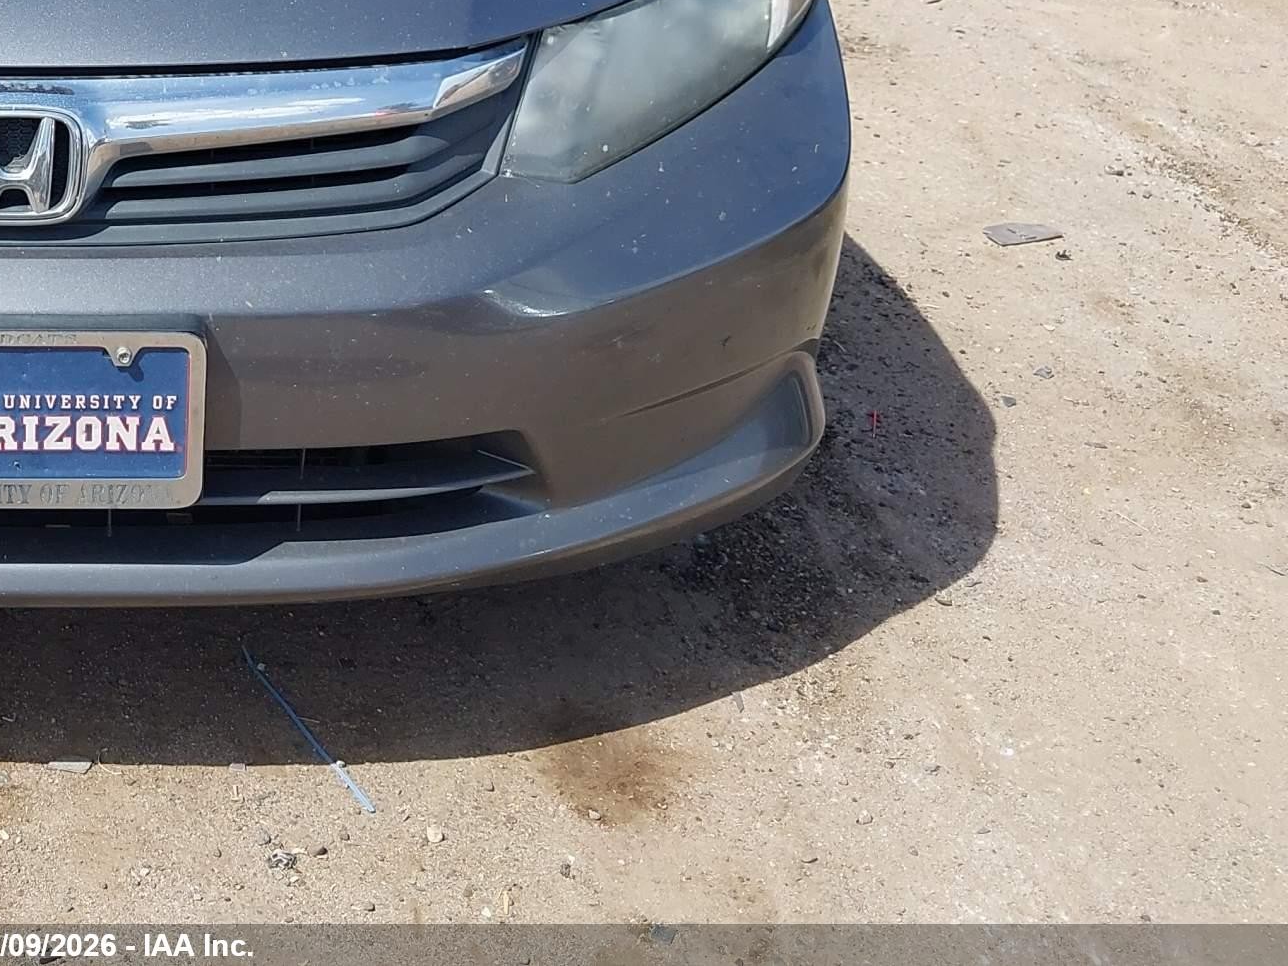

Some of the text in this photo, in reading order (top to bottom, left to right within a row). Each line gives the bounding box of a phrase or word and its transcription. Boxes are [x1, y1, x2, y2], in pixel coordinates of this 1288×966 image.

[3, 394, 140, 410] UNIVERSITY
[152, 395, 177, 410] OF
[39, 483, 70, 506] OF
